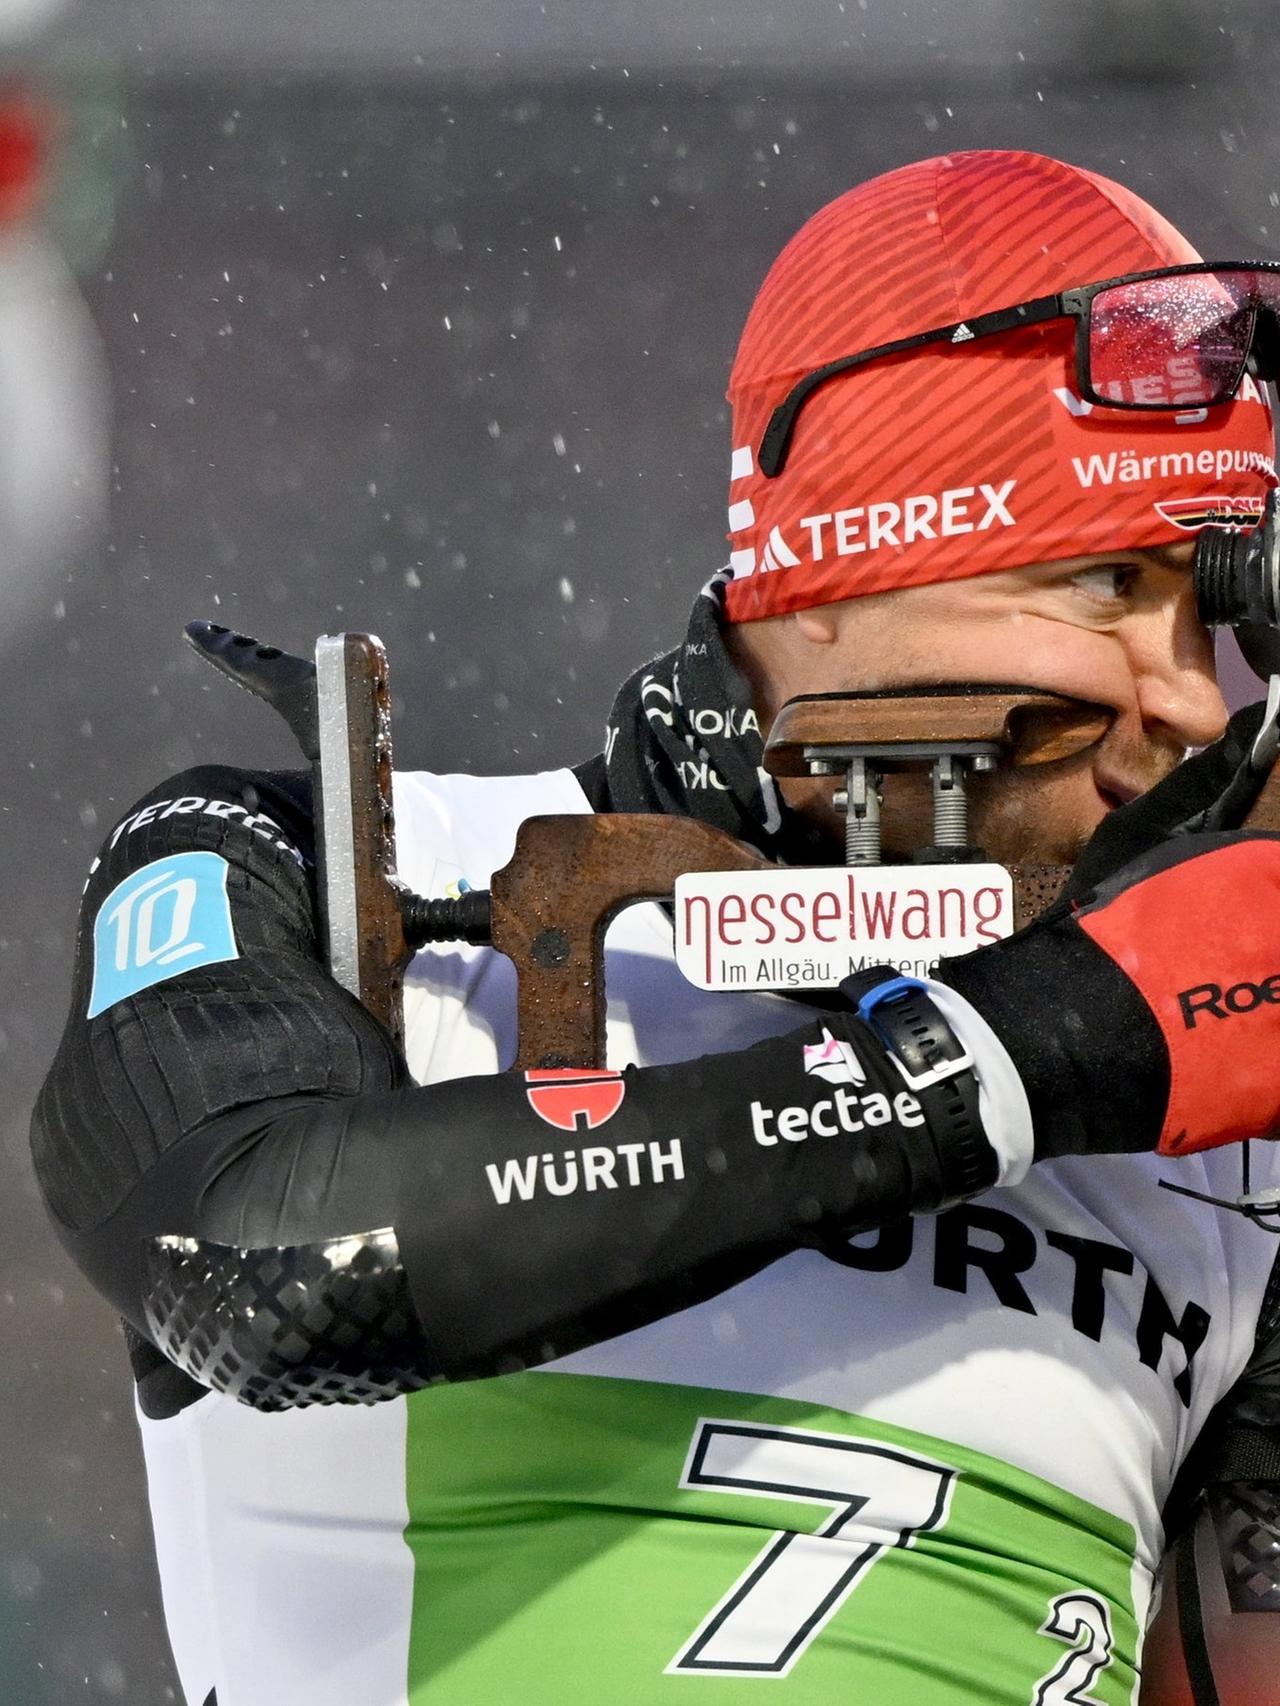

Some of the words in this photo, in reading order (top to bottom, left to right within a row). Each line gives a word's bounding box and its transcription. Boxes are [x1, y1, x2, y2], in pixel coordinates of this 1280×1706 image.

[800, 480, 1017, 562] TERREX
[684, 874, 1004, 984] nesselwang
[721, 960, 747, 983] Im
[756, 957, 839, 986] Allgäu.
[662, 1417, 965, 1679] 7
[1029, 1589, 1115, 1706] 2
